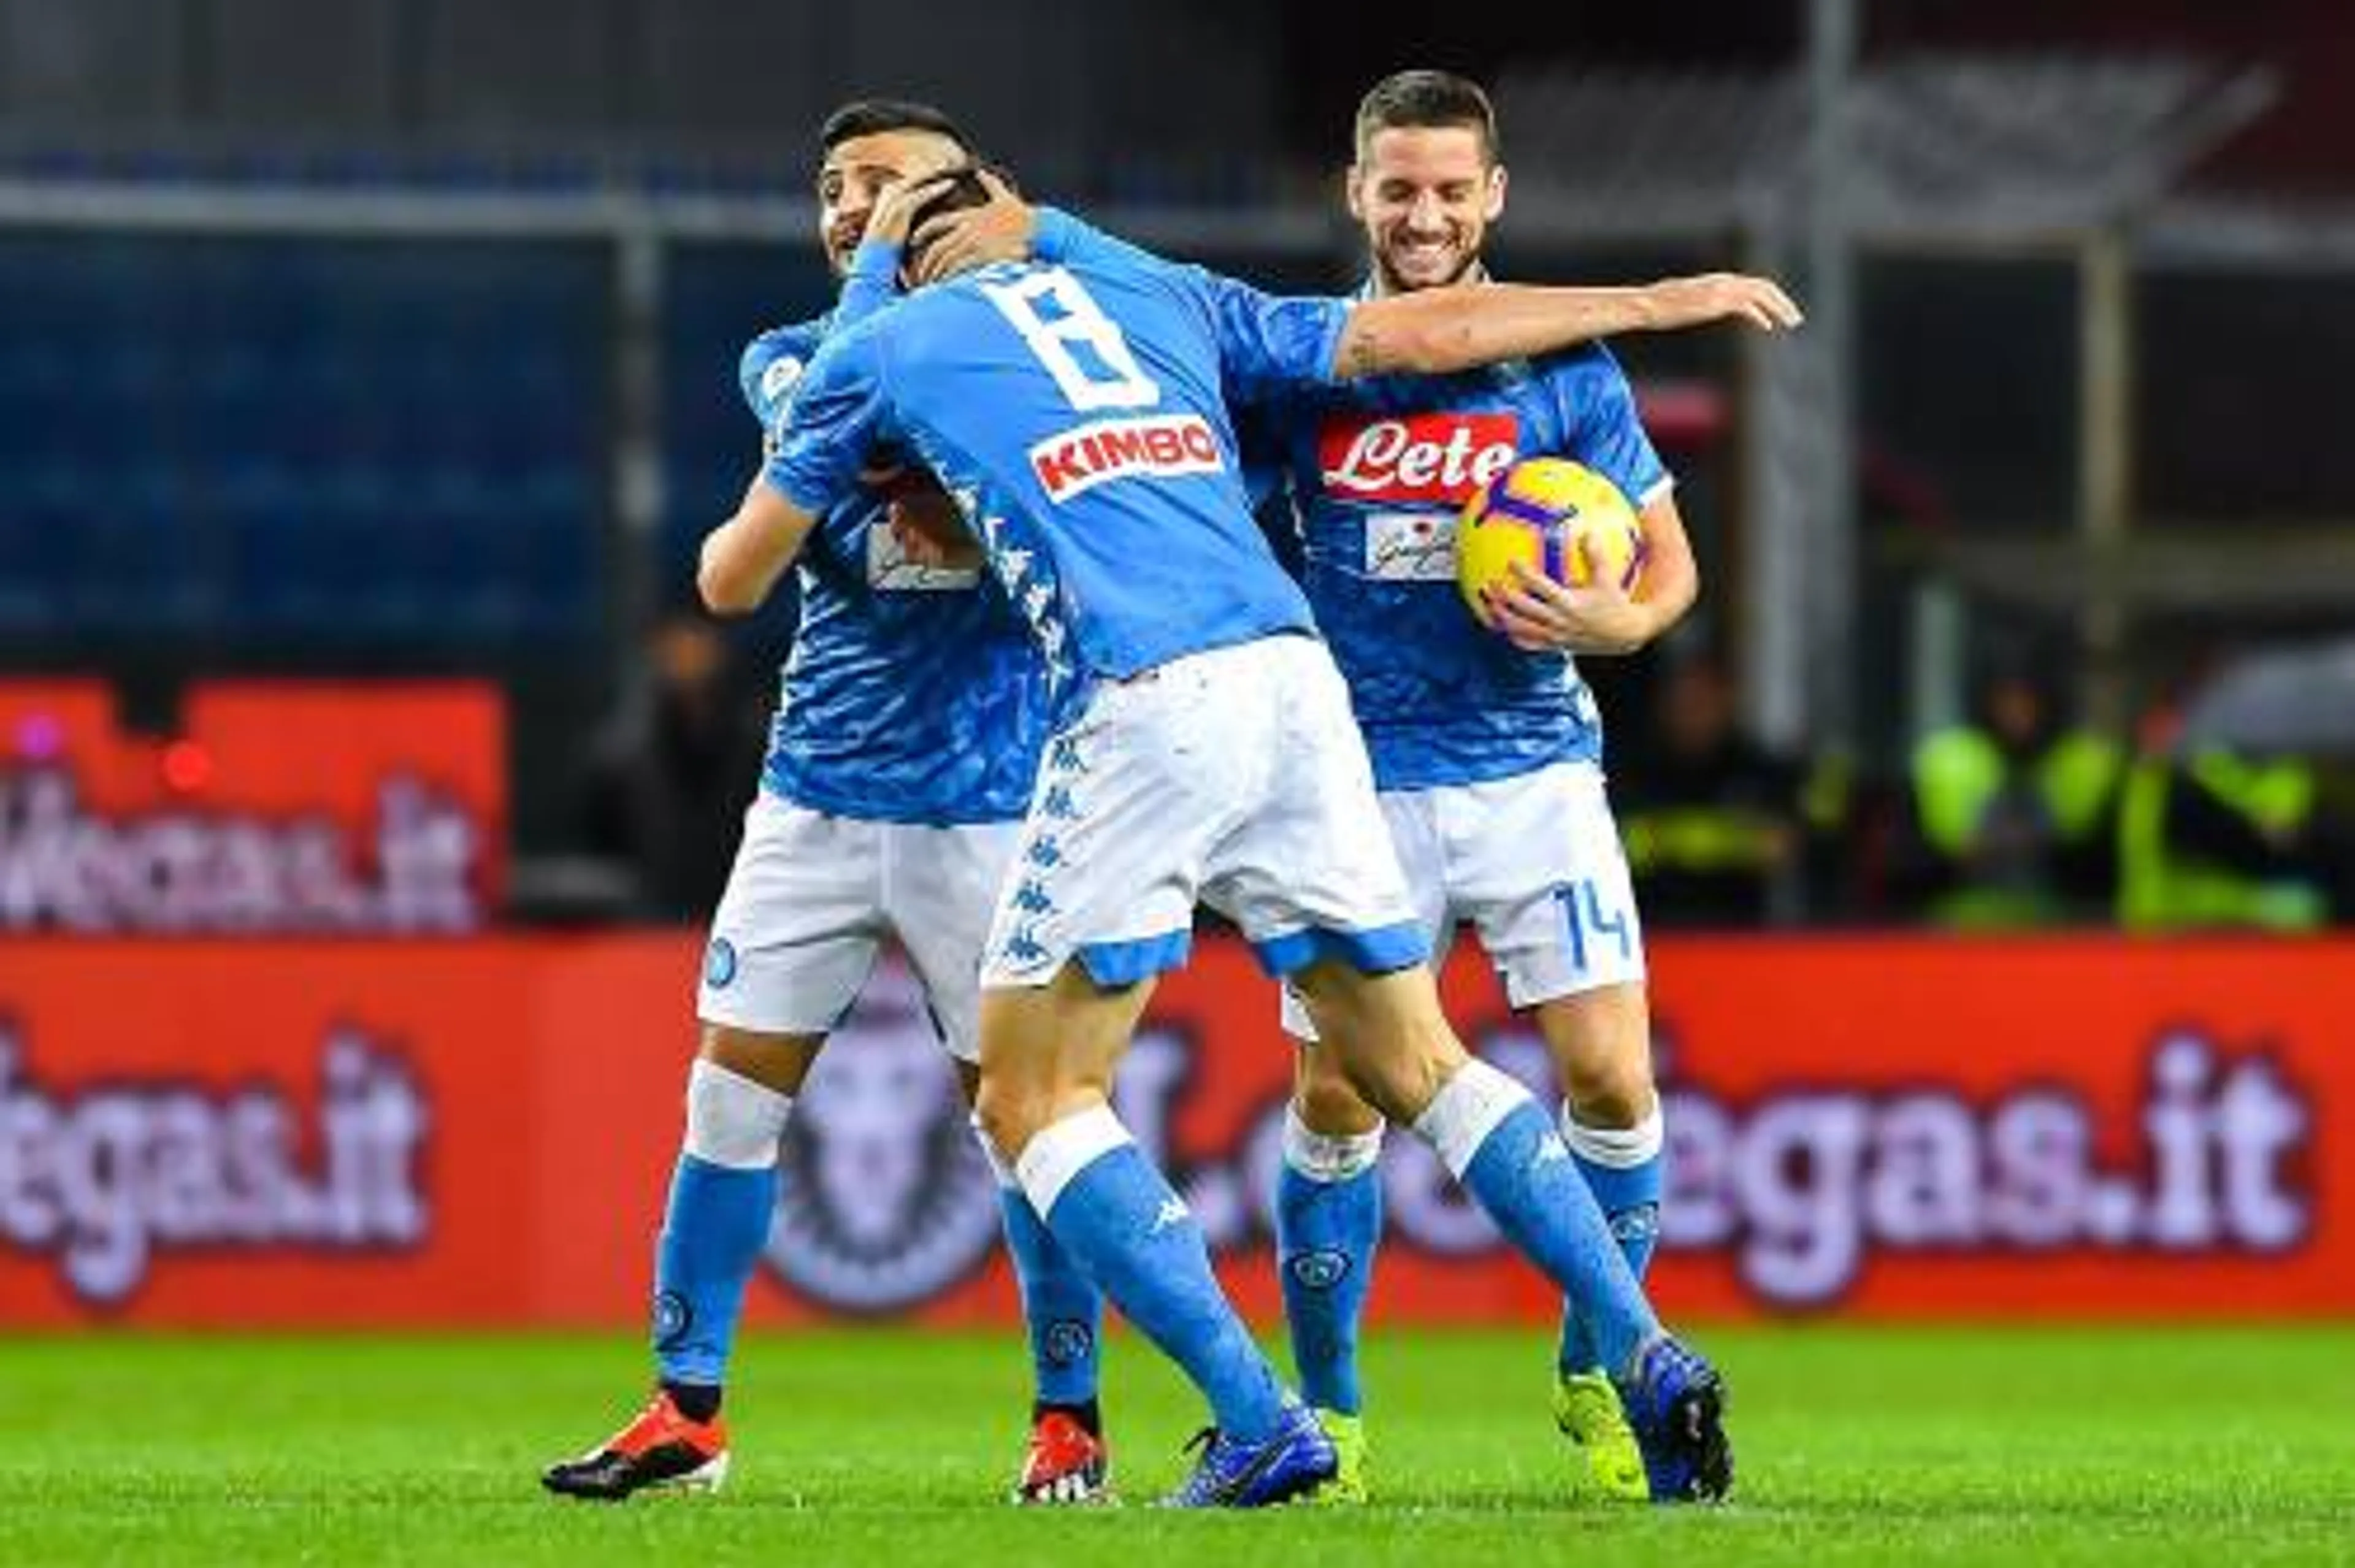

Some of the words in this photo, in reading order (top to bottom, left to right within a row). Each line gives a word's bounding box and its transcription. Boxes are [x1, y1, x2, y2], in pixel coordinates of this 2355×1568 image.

[981, 267, 1160, 410] 8
[1036, 424, 1217, 492] KIMBO
[1323, 421, 1515, 491] Lete
[1554, 878, 1631, 971] 14
[0, 1021, 424, 1299] egas.it
